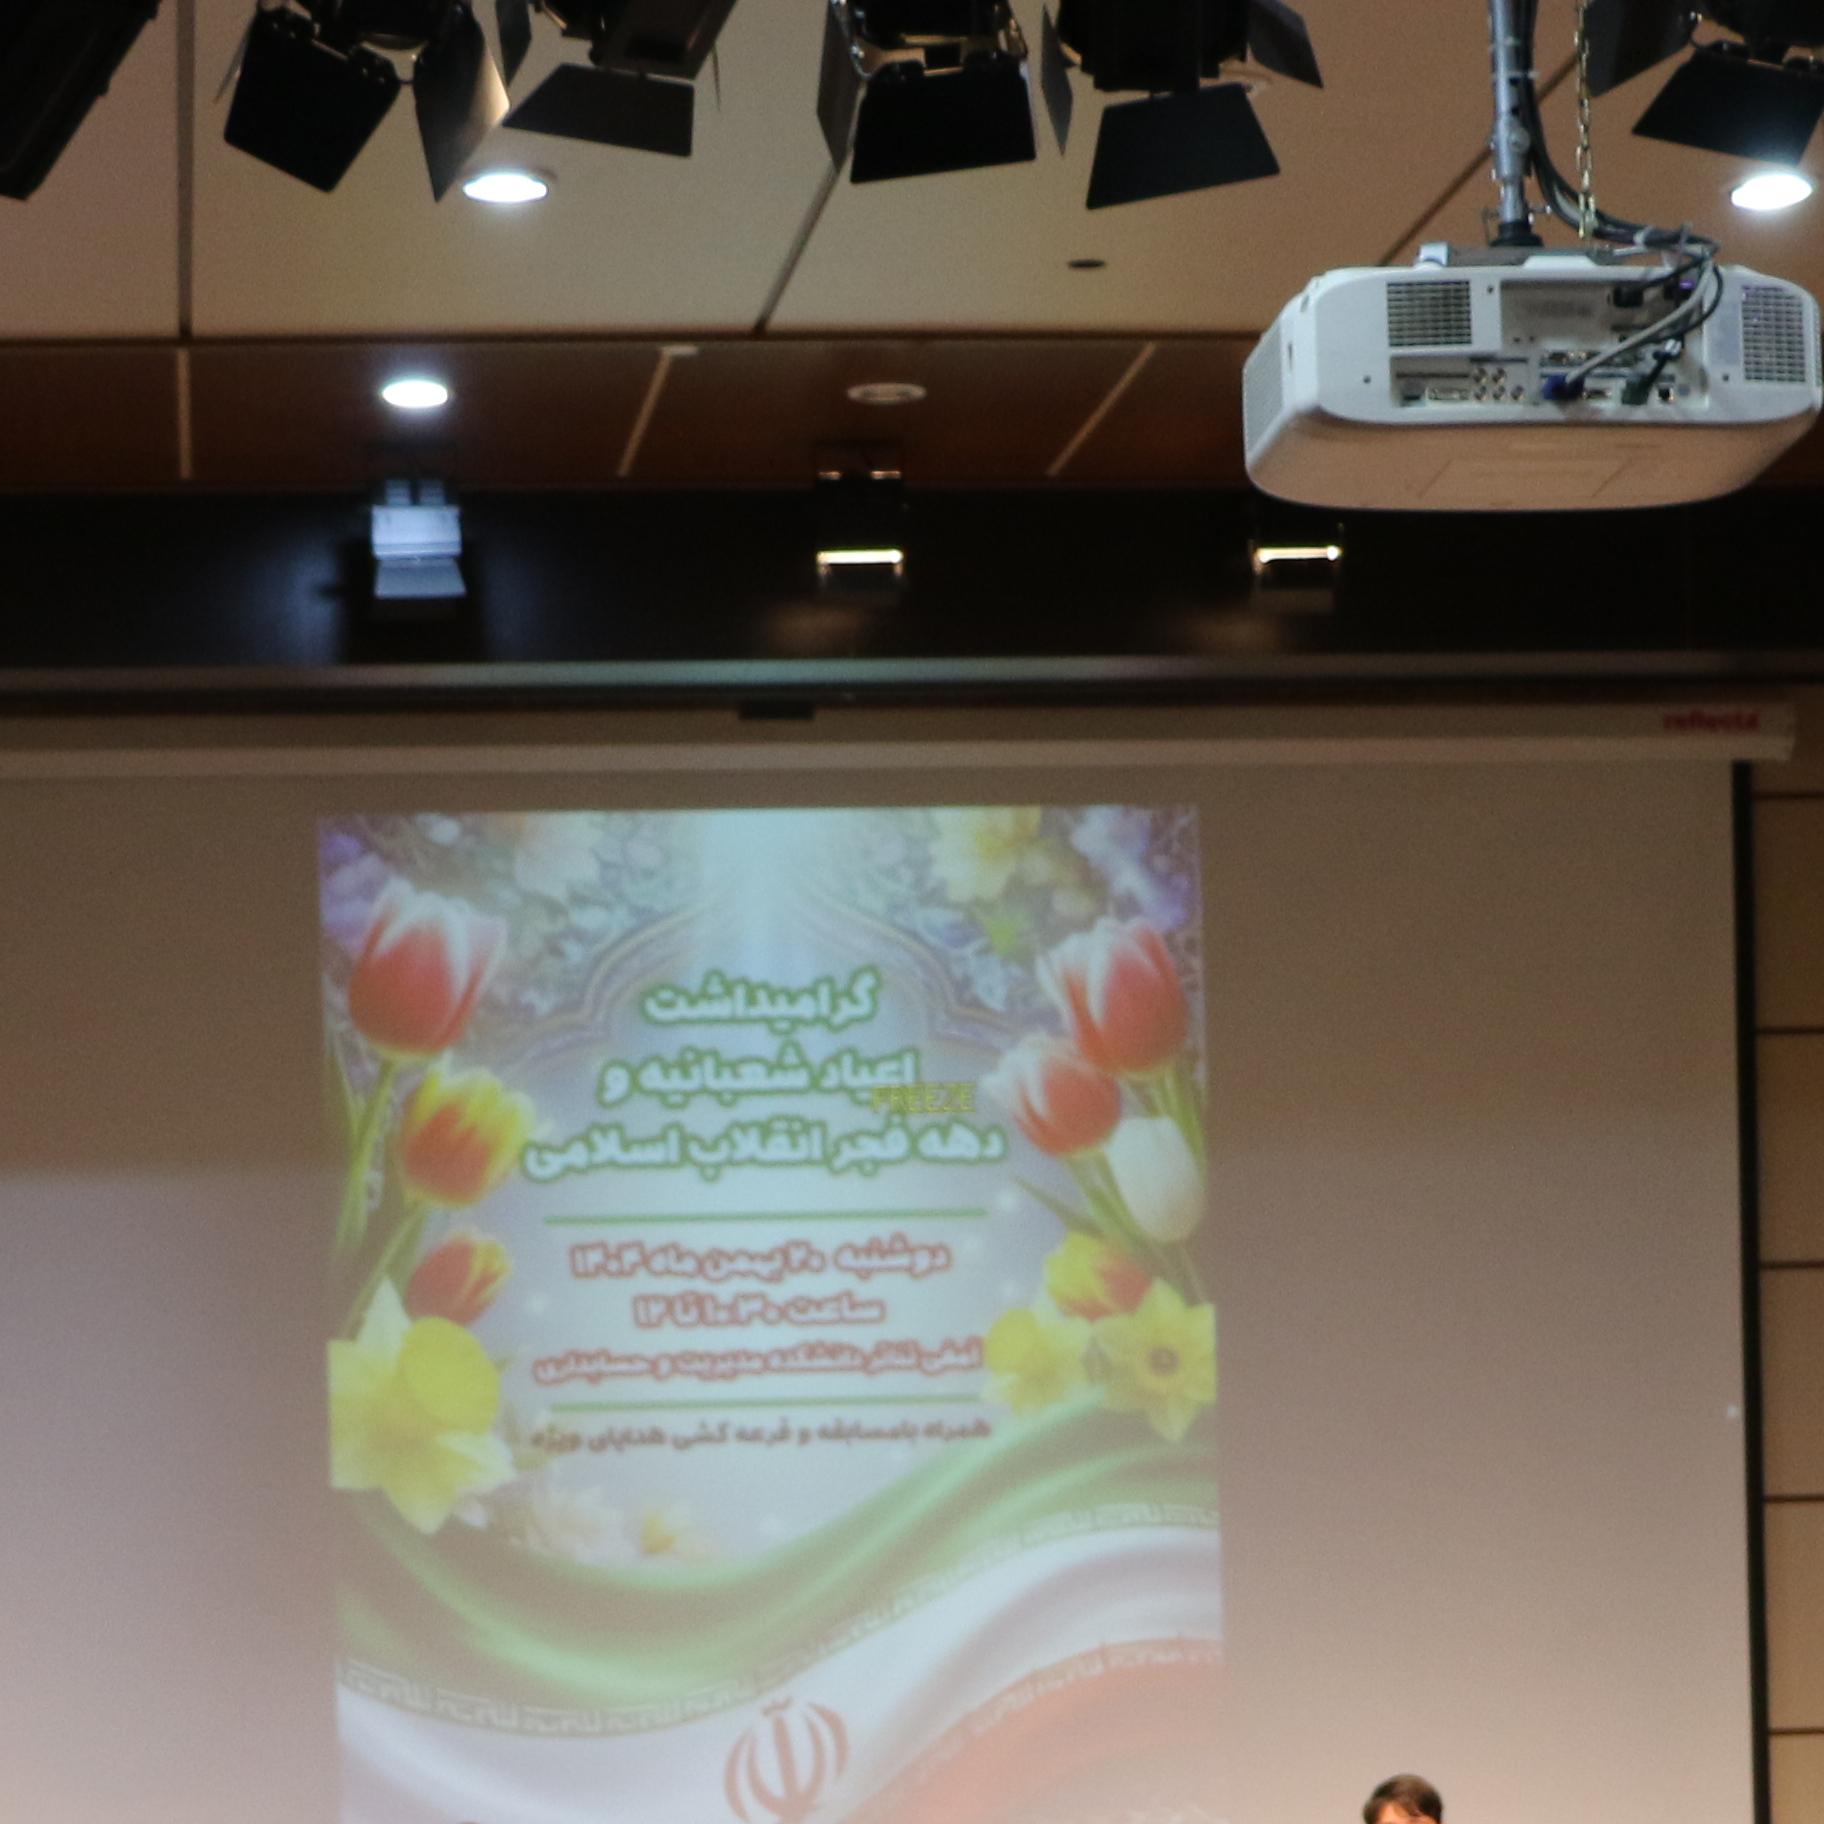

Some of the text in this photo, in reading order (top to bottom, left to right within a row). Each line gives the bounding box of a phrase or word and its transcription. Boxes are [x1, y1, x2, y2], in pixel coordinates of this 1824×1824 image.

[643, 965, 881, 1034] گرامیداشت
[597, 1060, 635, 1109] و
[637, 1038, 814, 1108] شعبانیه
[522, 1113, 1008, 1182] دهه فجر انقلاب اسلامی
[834, 1233, 952, 1280] دوشنبه
